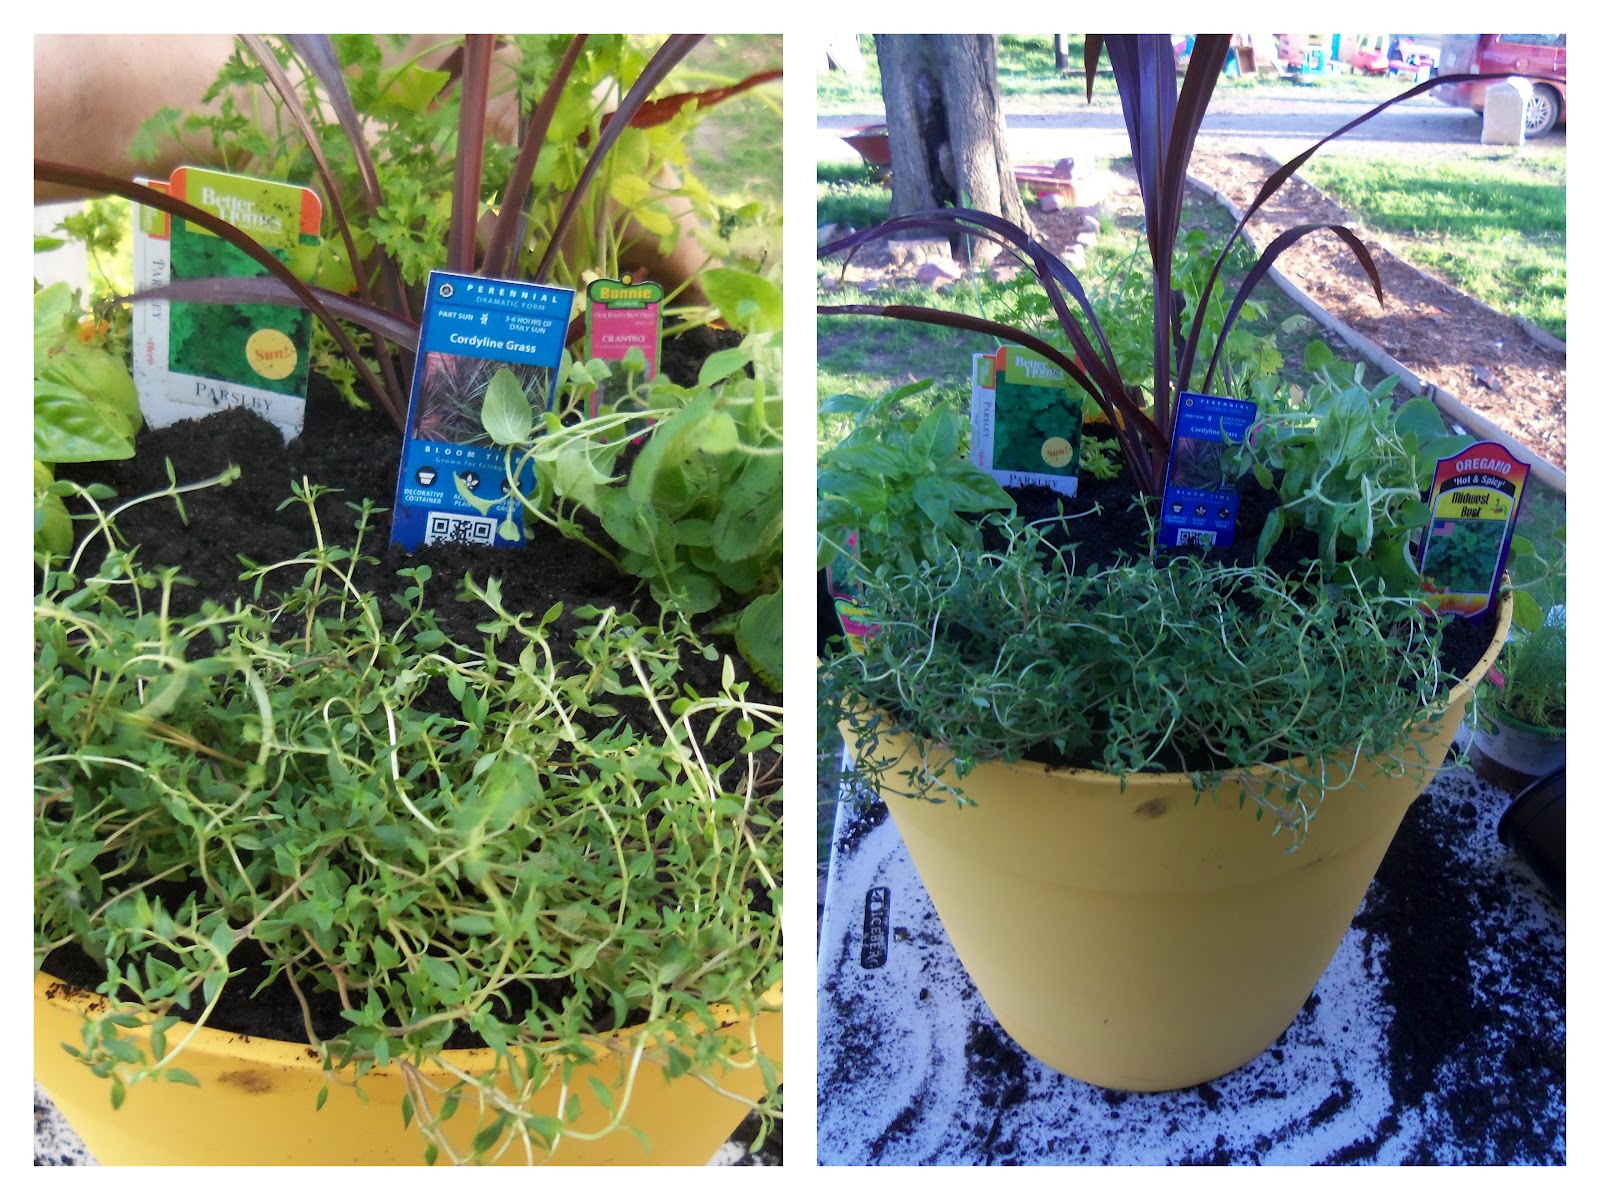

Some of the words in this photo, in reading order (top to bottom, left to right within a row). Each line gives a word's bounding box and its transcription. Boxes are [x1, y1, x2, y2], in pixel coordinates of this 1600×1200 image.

[202, 187, 255, 209] Better
[152, 259, 165, 320] PAREY
[467, 284, 558, 304] PERENNIAL
[601, 287, 652, 299] Bonnie
[476, 295, 519, 308] DRAMATIC
[521, 301, 546, 312] FORM
[438, 310, 457, 319] PART
[458, 312, 474, 321] SUN
[517, 317, 542, 327] HOURS
[543, 319, 552, 327] OF
[509, 323, 530, 333] DAILY
[531, 326, 546, 335] SUN
[450, 333, 504, 350] Cordyline
[506, 340, 536, 353] Grass
[602, 335, 645, 343] CILANTRO
[255, 347, 289, 361] Sun!
[1015, 356, 1048, 369] Better
[195, 382, 272, 411] PARSLEY
[1200, 399, 1249, 410] PERENNIAL
[983, 401, 991, 439] PARSLEY
[1191, 426, 1220, 435] Cordyline
[424, 445, 476, 459] BLOOM
[486, 454, 521, 465] TIE
[435, 457, 462, 467] Grown
[1455, 458, 1511, 474] OREGANO
[1009, 475, 1057, 488] PARSLEY
[1472, 475, 1479, 483] &
[404, 488, 444, 499] DECORATIVE
[1452, 492, 1489, 505] Midwest
[405, 495, 442, 505] CONTAINER
[454, 500, 472, 508] PLAN
[1461, 506, 1481, 518] Best
